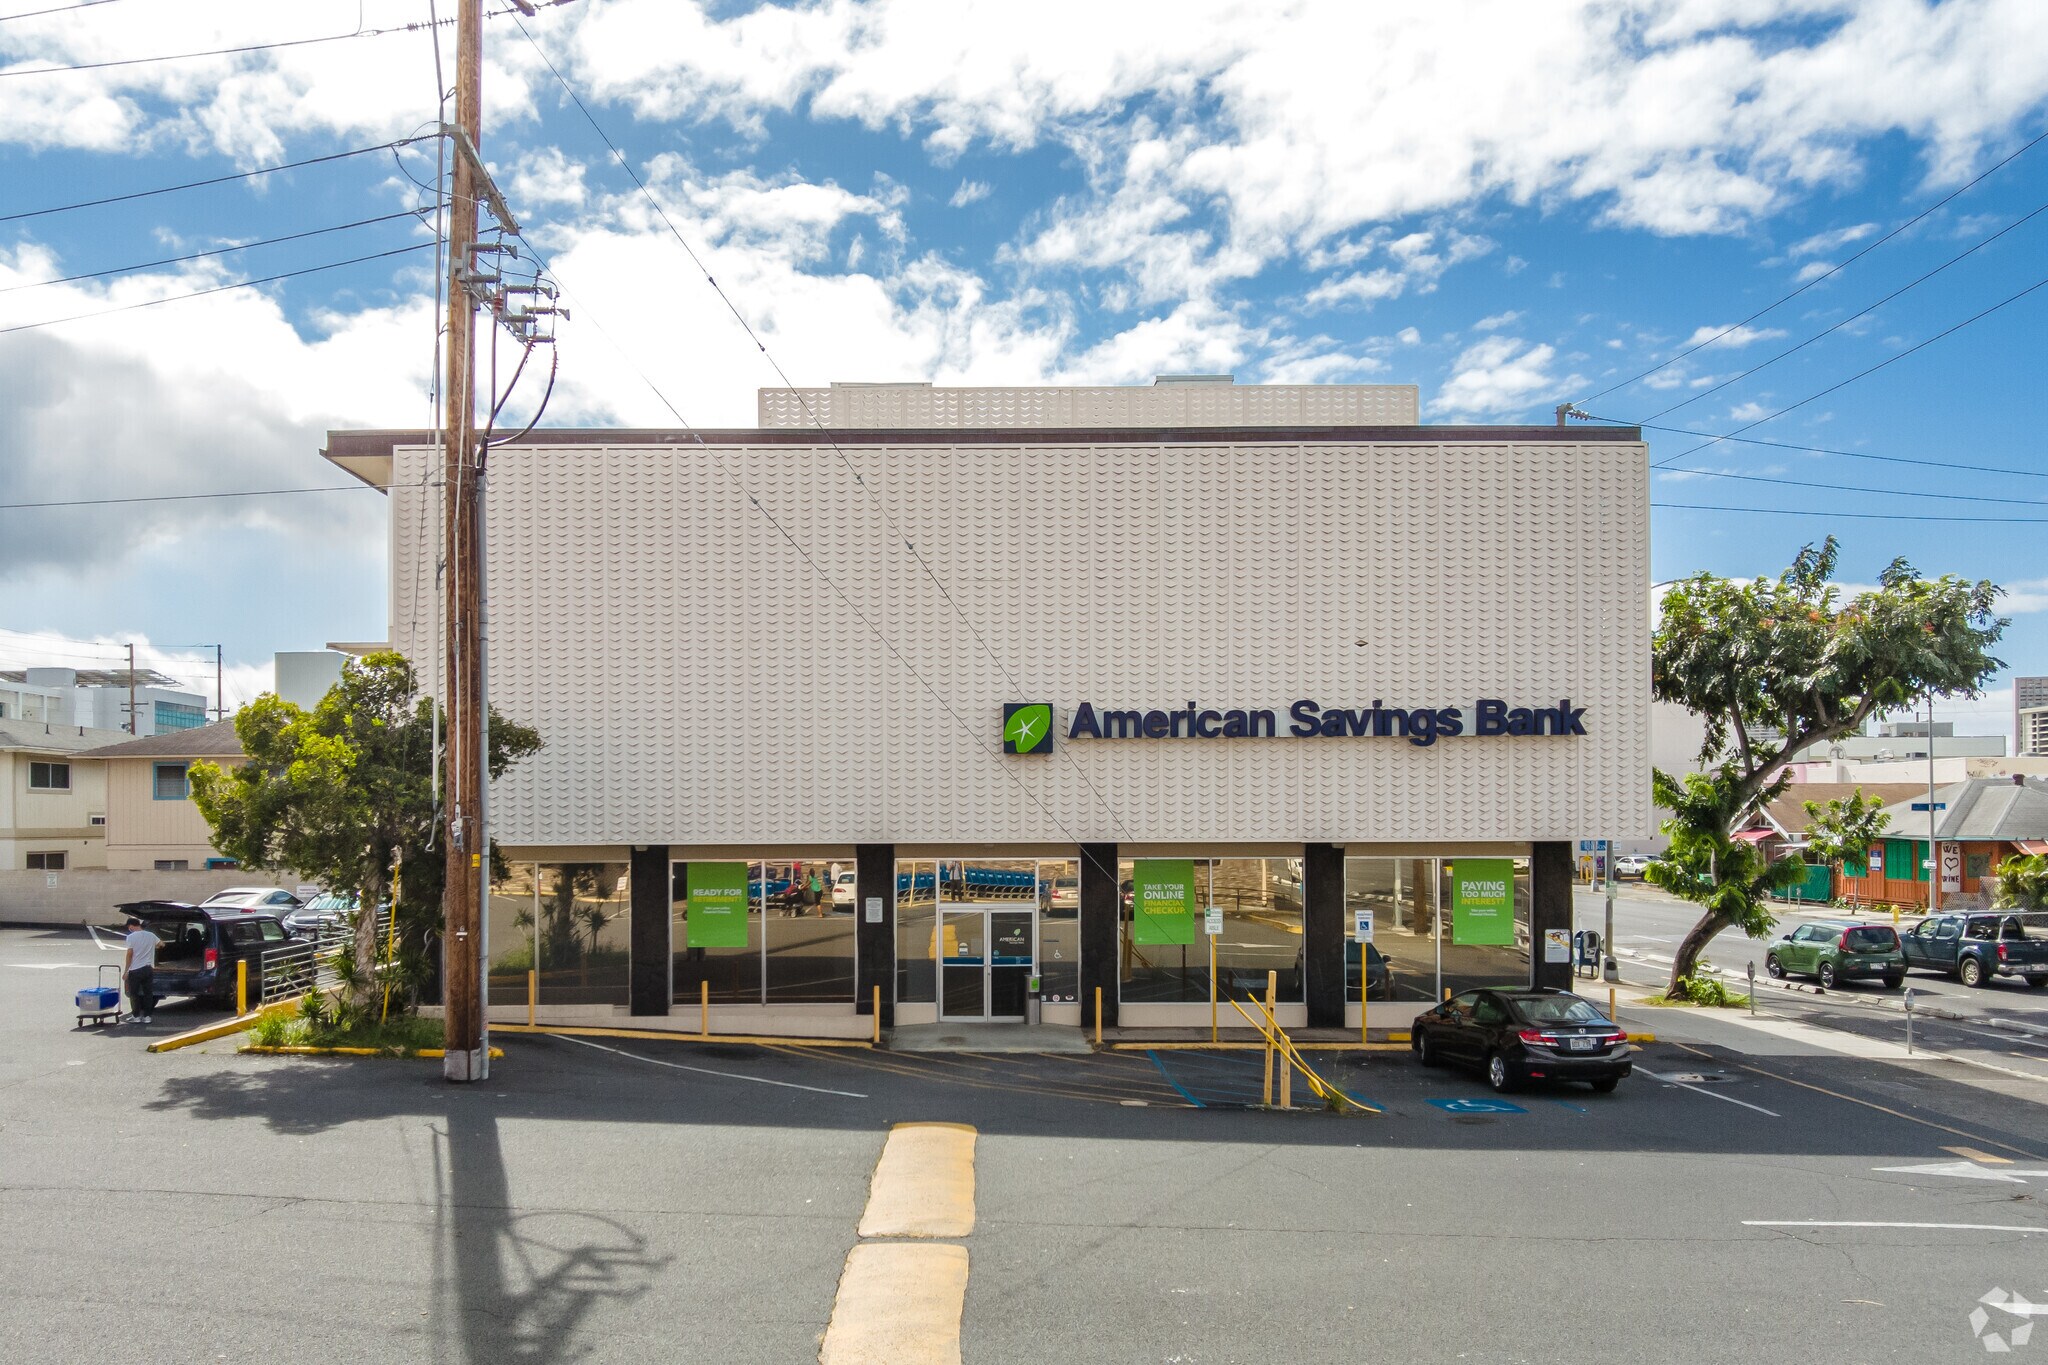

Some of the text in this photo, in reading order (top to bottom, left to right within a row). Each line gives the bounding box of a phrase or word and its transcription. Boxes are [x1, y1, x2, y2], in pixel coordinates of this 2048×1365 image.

[1068, 699, 1588, 746] American Savings Bank
[1943, 844, 1958, 854] WE
[1461, 881, 1506, 891] PAYING
[1143, 890, 1185, 900] ONLINE
